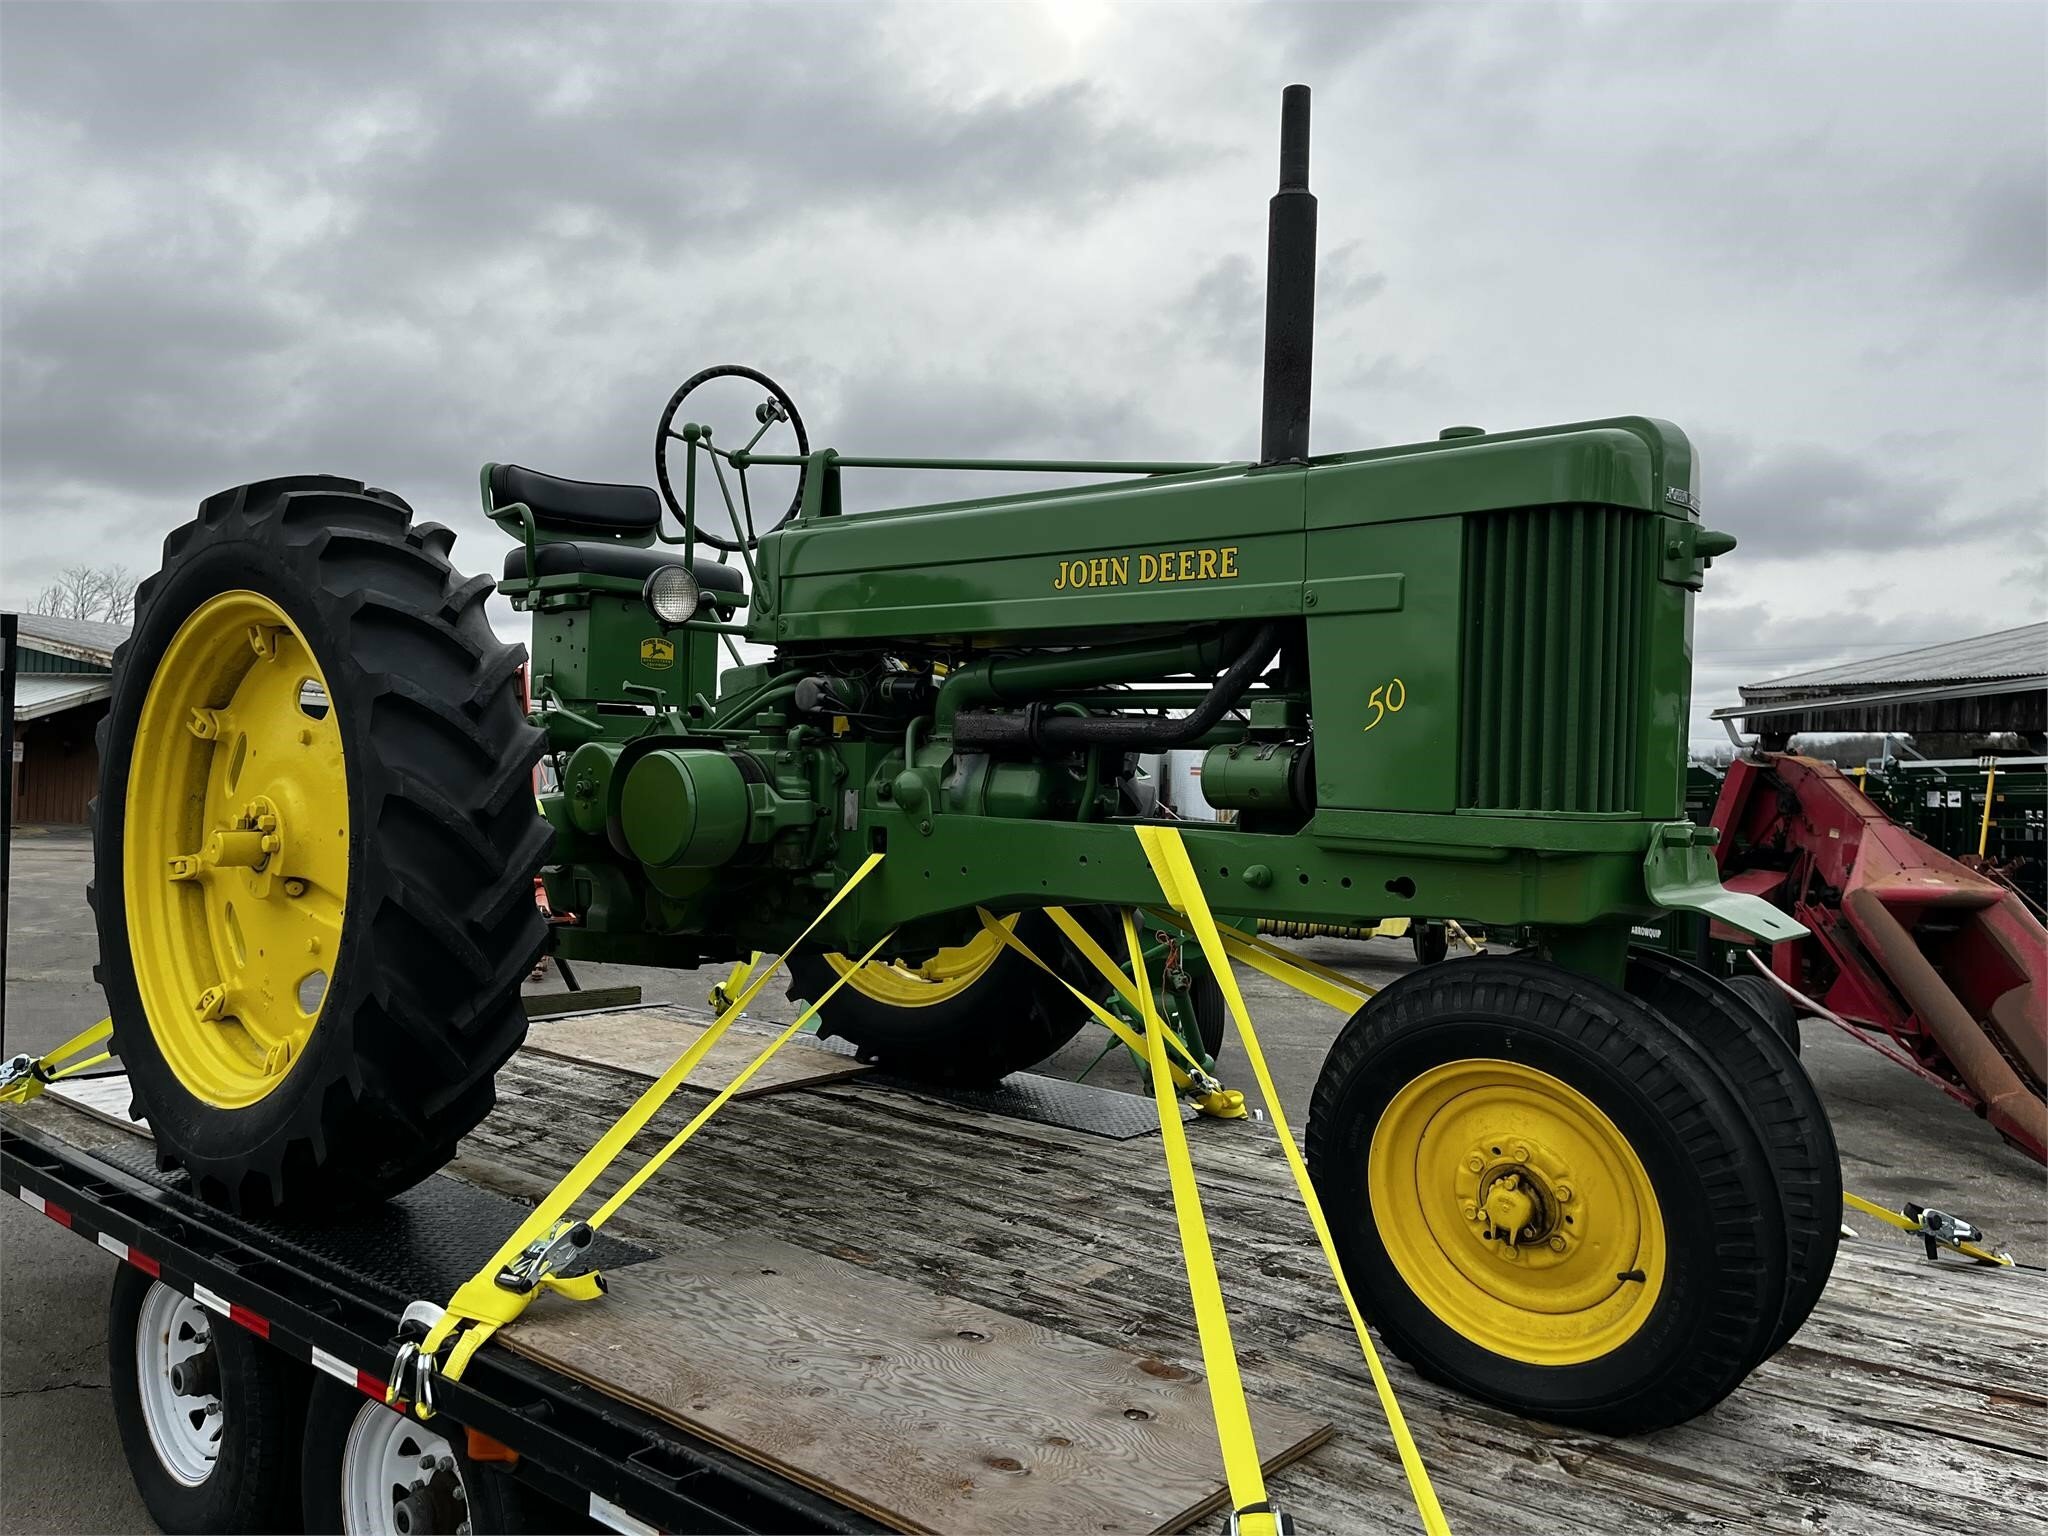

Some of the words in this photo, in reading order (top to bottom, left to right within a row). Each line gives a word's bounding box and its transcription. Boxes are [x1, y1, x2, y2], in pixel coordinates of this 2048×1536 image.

[1054, 556, 1130, 590] JOHN
[1138, 547, 1239, 584] DEERE
[1363, 678, 1406, 731] 50
[1630, 926, 1662, 939] ARROWQUIP
